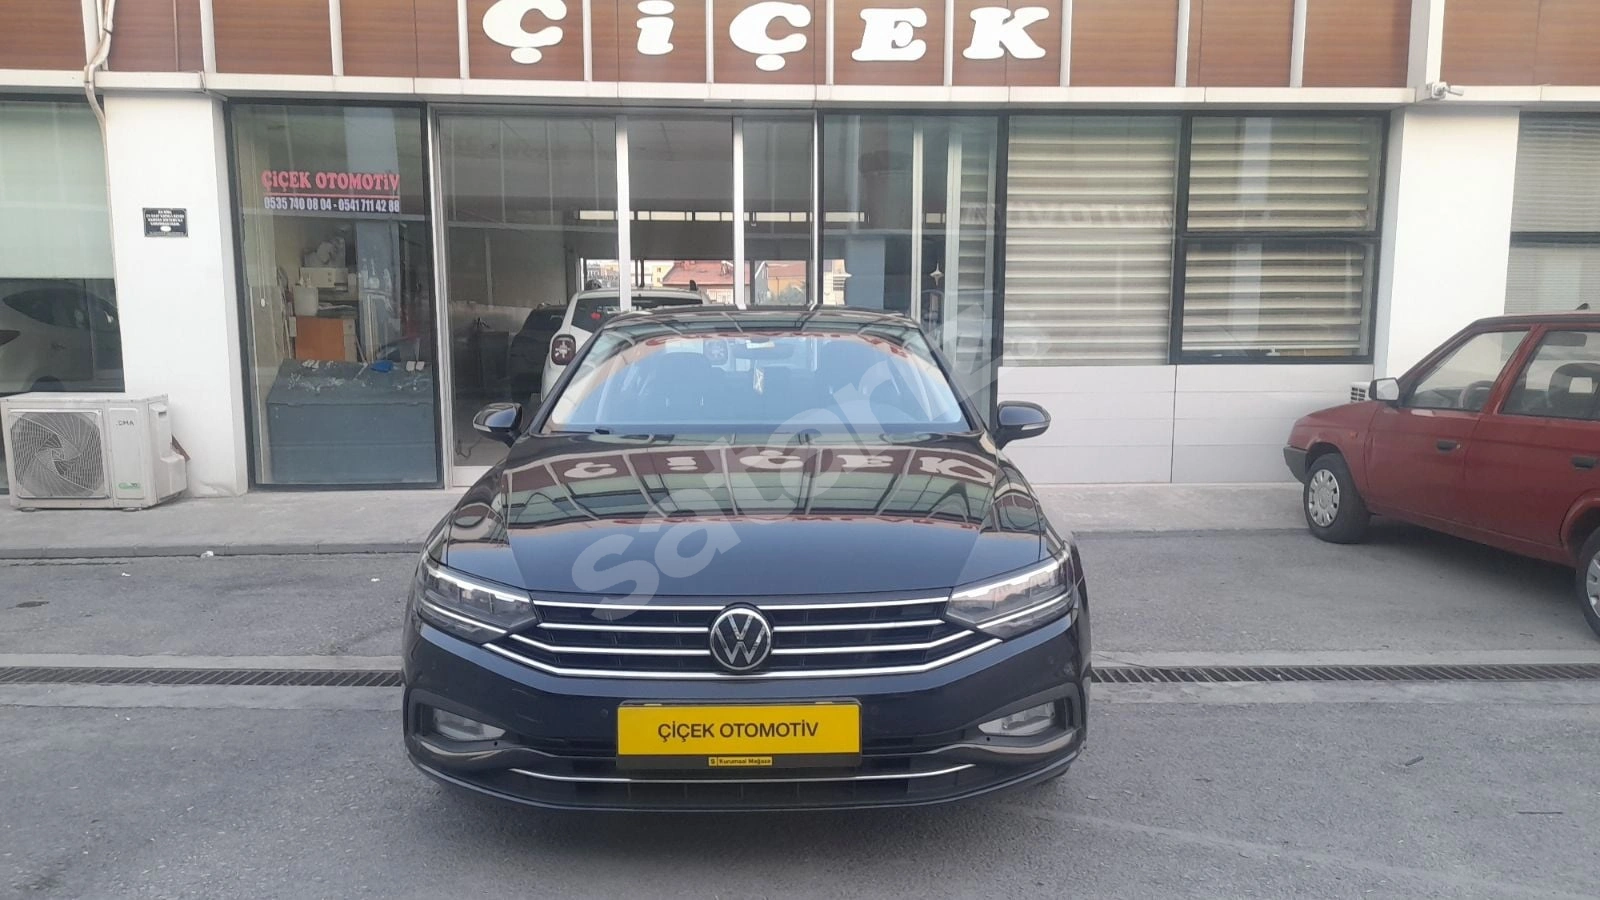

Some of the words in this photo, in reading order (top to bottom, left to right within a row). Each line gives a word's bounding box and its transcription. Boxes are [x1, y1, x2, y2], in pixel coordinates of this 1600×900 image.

[264, 196, 288, 209] 0535
[289, 197, 305, 210] 740
[320, 198, 332, 211] 04
[338, 199, 359, 212] 0541
[361, 199, 374, 212] 711
[375, 200, 386, 212] 42
[658, 720, 715, 742] ÇİÇEK
[719, 720, 819, 738] OTOMOTİV
